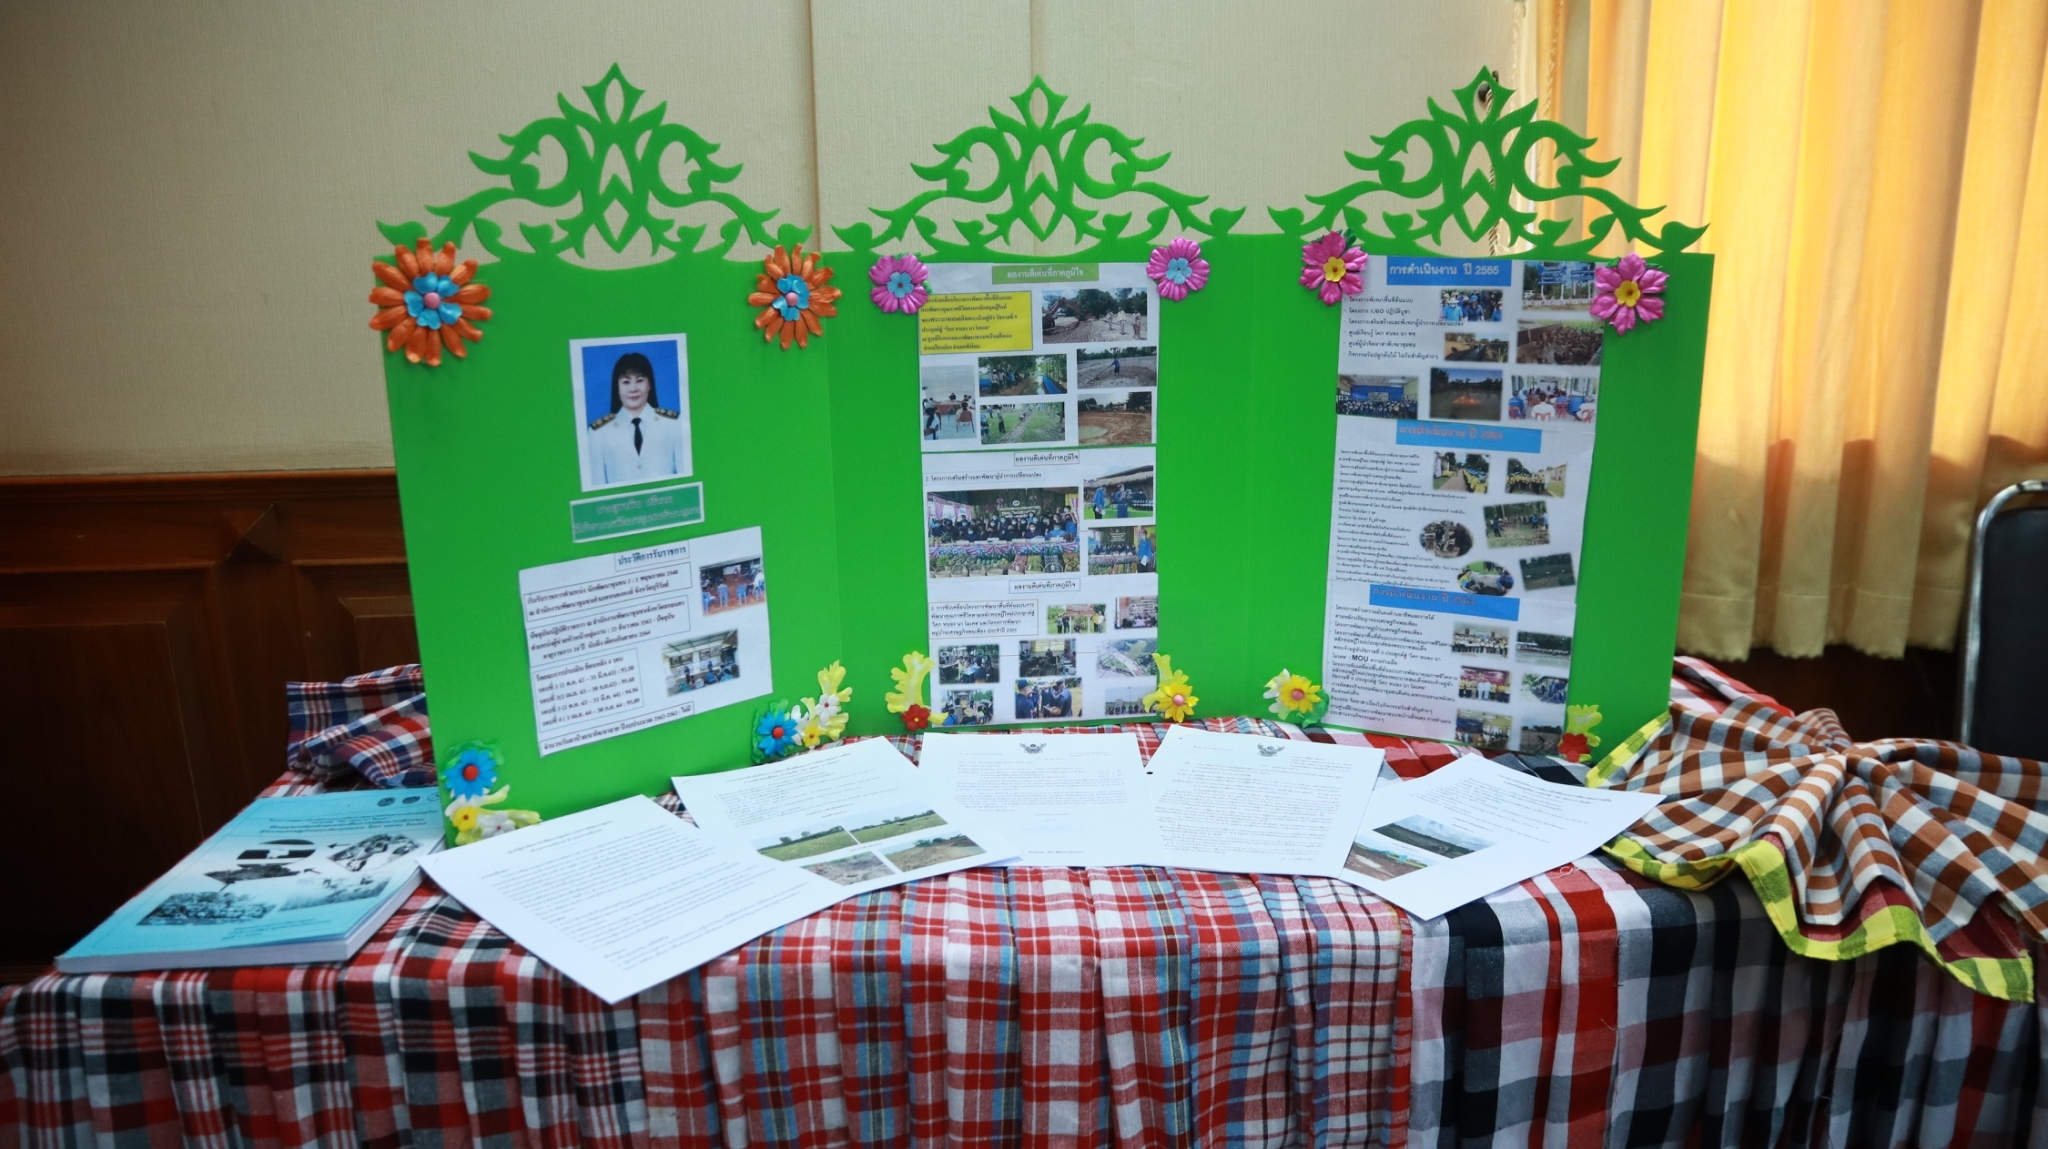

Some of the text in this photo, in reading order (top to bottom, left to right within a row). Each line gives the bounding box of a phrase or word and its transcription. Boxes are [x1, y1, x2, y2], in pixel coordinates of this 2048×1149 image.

[1008, 266, 1083, 278] ผลงานดีเด่นที่ภาคภูมิใจ
[1390, 262, 1500, 276] การดำเนินงาน ปี 2565
[1399, 422, 1466, 439] การดำเนินงาน
[1467, 426, 1477, 438] ปี
[1016, 453, 1078, 462] ผลงานดีเด่นที่ภาคภูมิใจ
[618, 547, 686, 564] ประวัติการรับราชการ
[1013, 580, 1076, 591] ผลงานดีเด่นที่ภาคภูมิใจ
[1372, 585, 1438, 602] การดำเนินงาน
[1440, 591, 1449, 602] ปี
[1351, 654, 1369, 662] MOU
